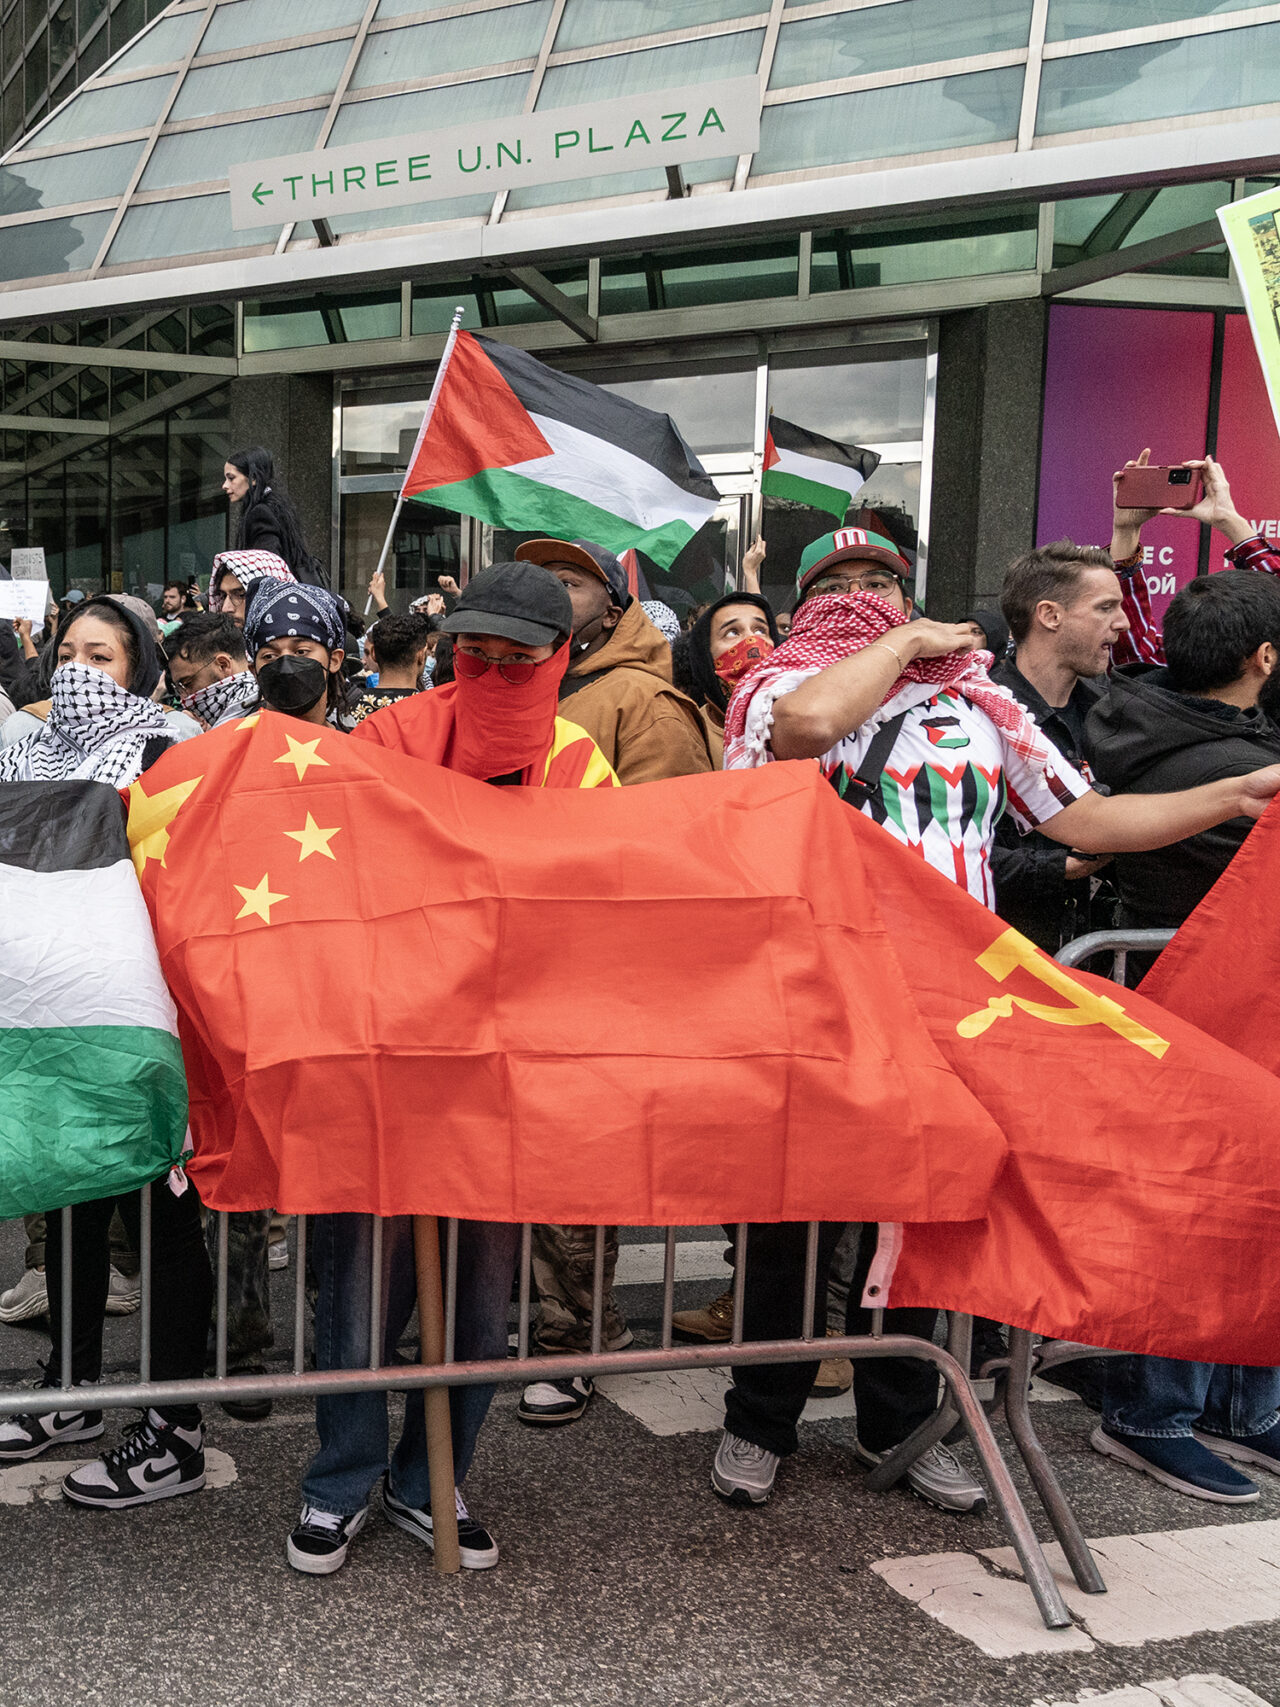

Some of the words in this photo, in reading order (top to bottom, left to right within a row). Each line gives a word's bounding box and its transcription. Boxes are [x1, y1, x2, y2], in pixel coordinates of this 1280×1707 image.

[283, 154, 432, 200] THREE
[458, 139, 532, 173] U.N.
[555, 107, 725, 158] PLAZA
